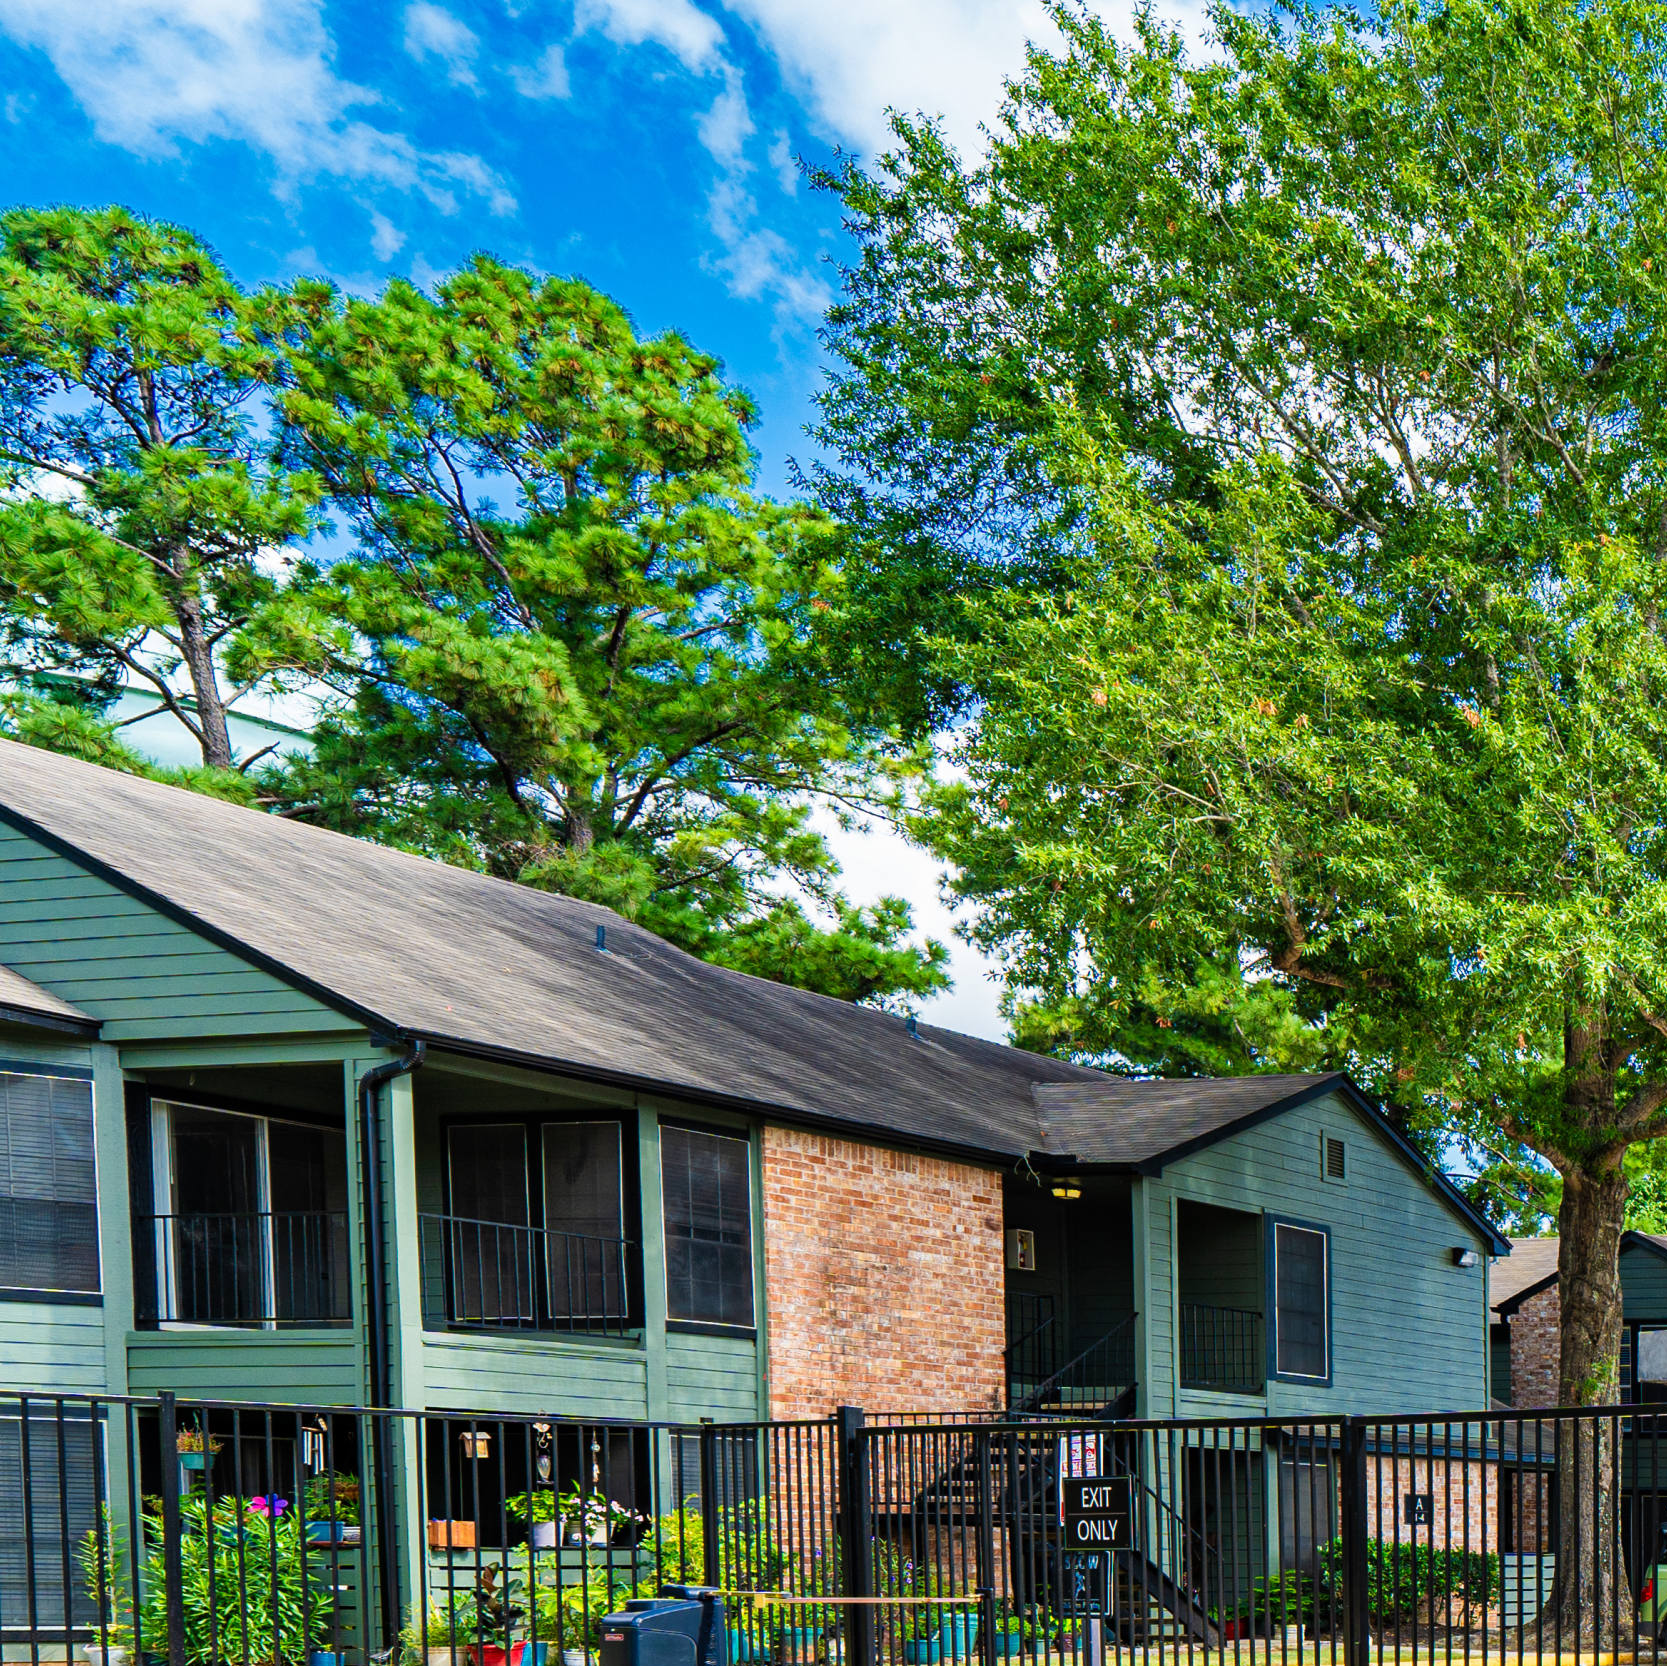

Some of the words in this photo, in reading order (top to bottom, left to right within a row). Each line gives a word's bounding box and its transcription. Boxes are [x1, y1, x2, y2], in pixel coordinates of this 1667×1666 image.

[1081, 1487, 1112, 1508] EXIT
[1416, 1498, 1424, 1510] A
[1077, 1519, 1118, 1540] ONLY
